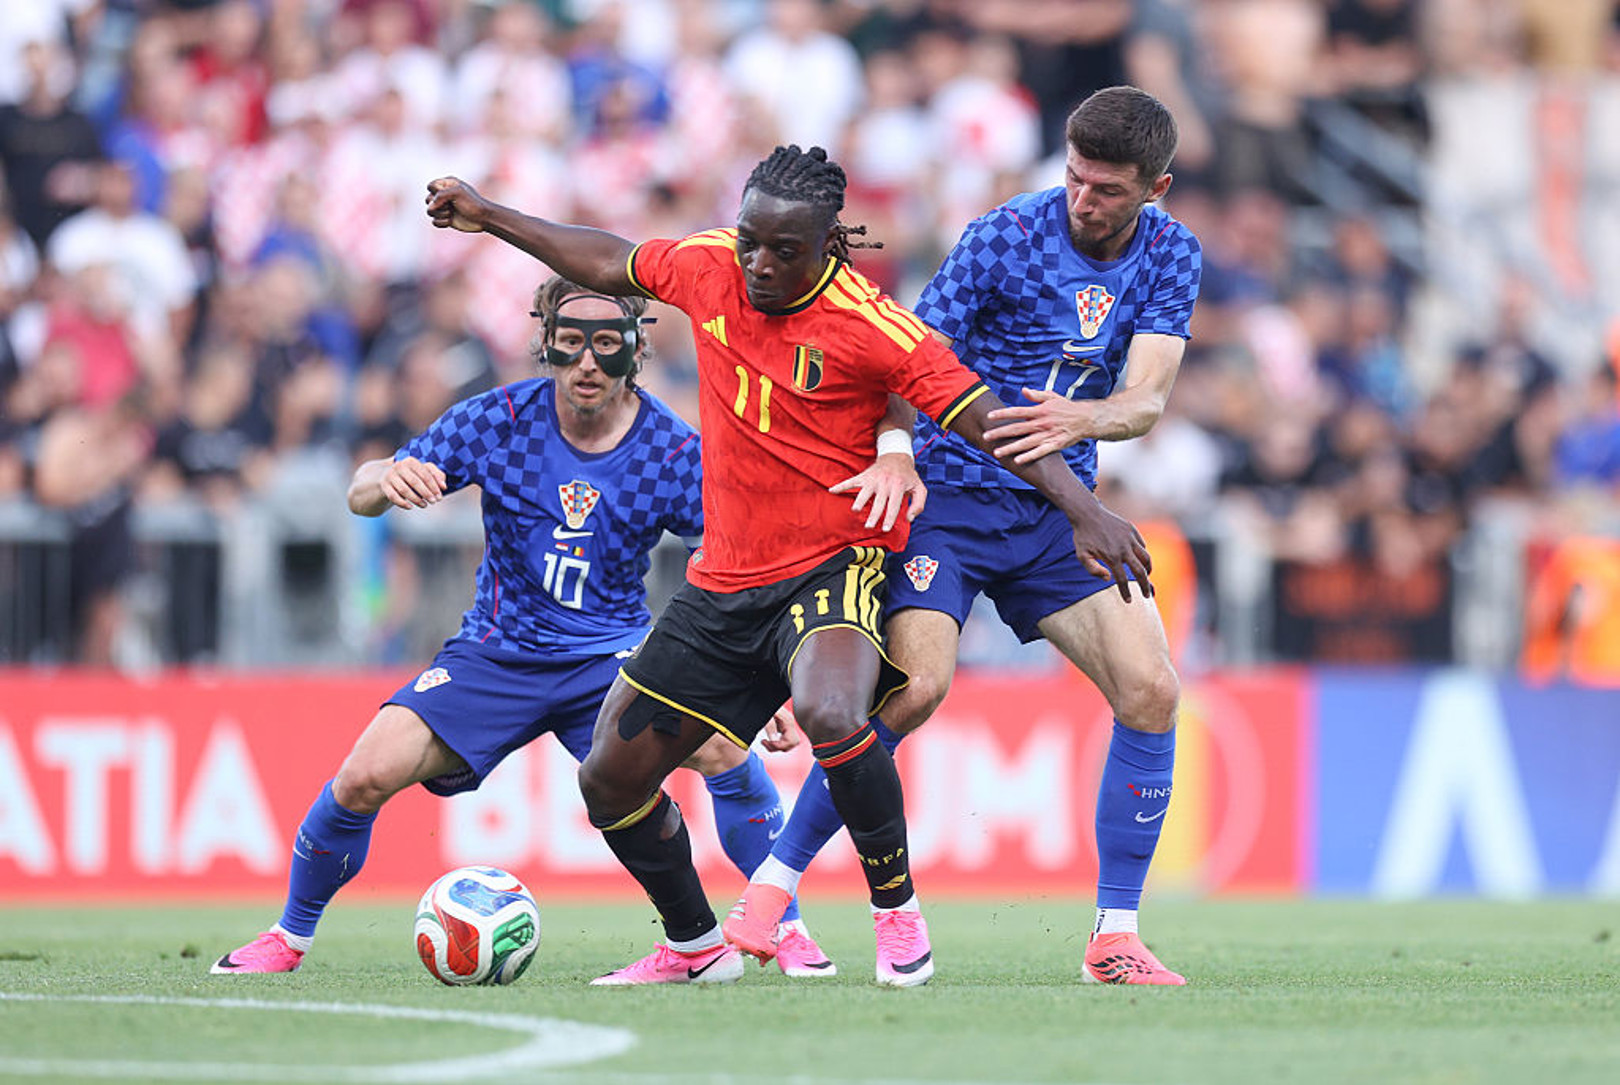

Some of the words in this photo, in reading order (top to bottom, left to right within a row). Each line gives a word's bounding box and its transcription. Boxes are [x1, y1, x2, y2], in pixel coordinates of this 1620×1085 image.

[734, 365, 773, 433] 11
[1045, 358, 1101, 400] 17
[542, 552, 591, 609] 10
